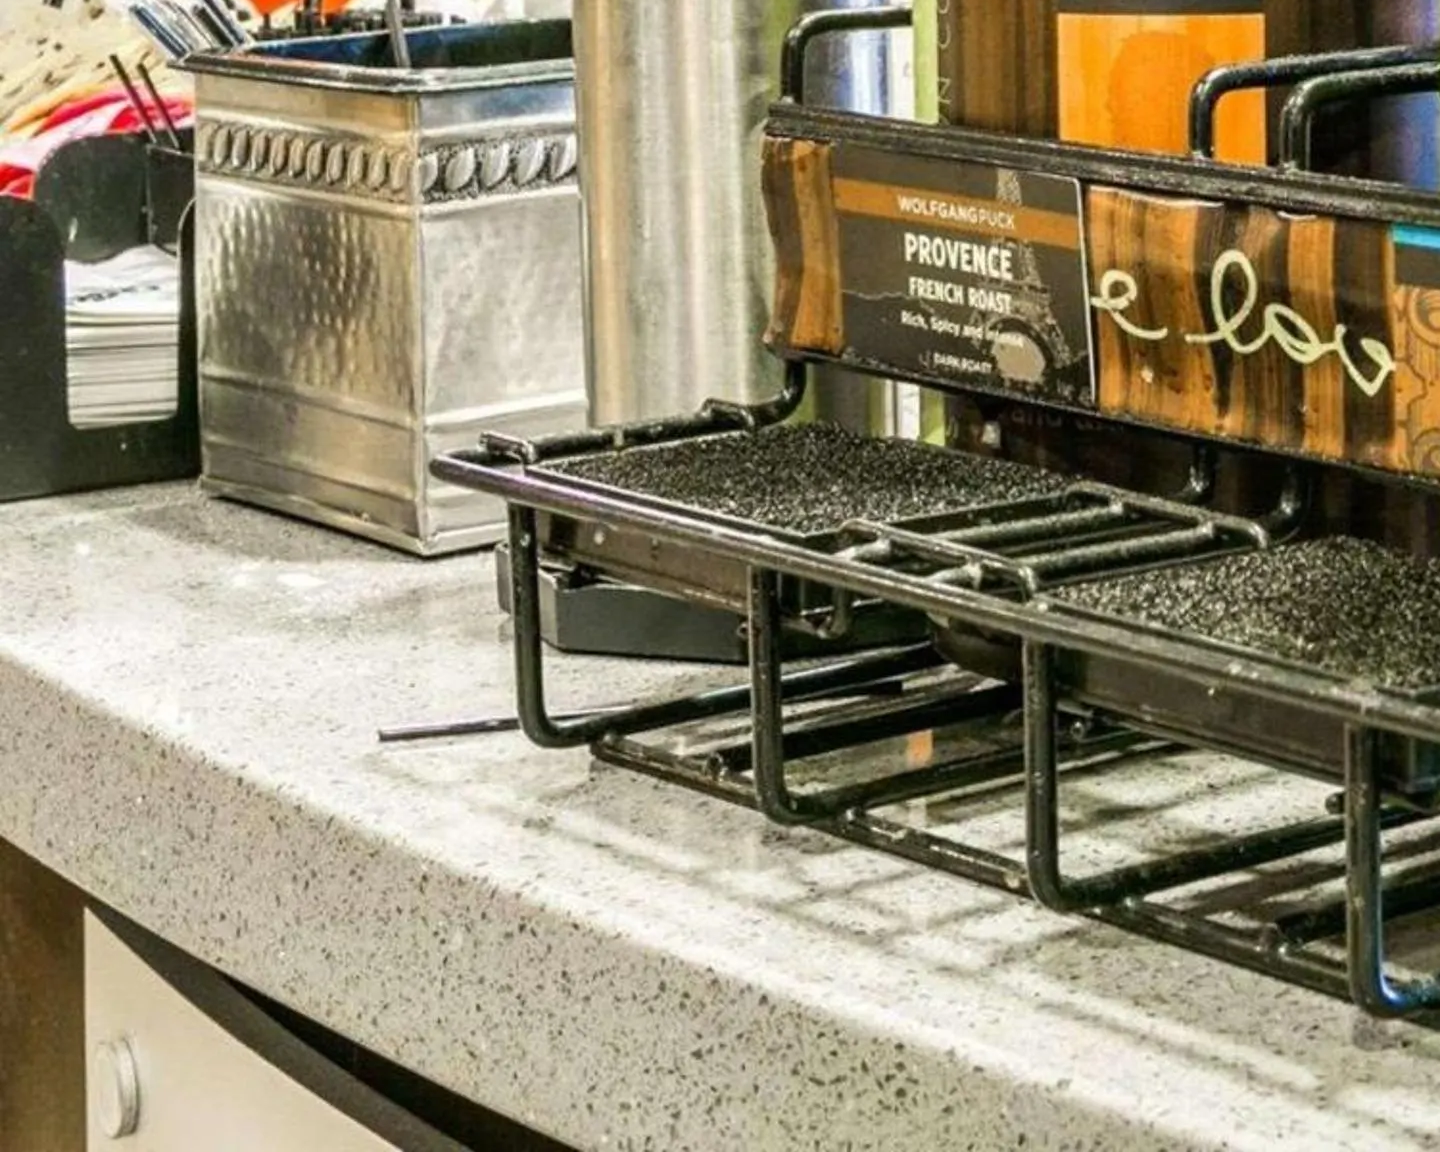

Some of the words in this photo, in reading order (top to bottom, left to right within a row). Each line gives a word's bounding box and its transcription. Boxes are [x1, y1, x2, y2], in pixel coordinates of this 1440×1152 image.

[904, 232, 1013, 281] PROVENCE
[909, 276, 964, 305] FRENCH
[968, 286, 1012, 314] ROAST
